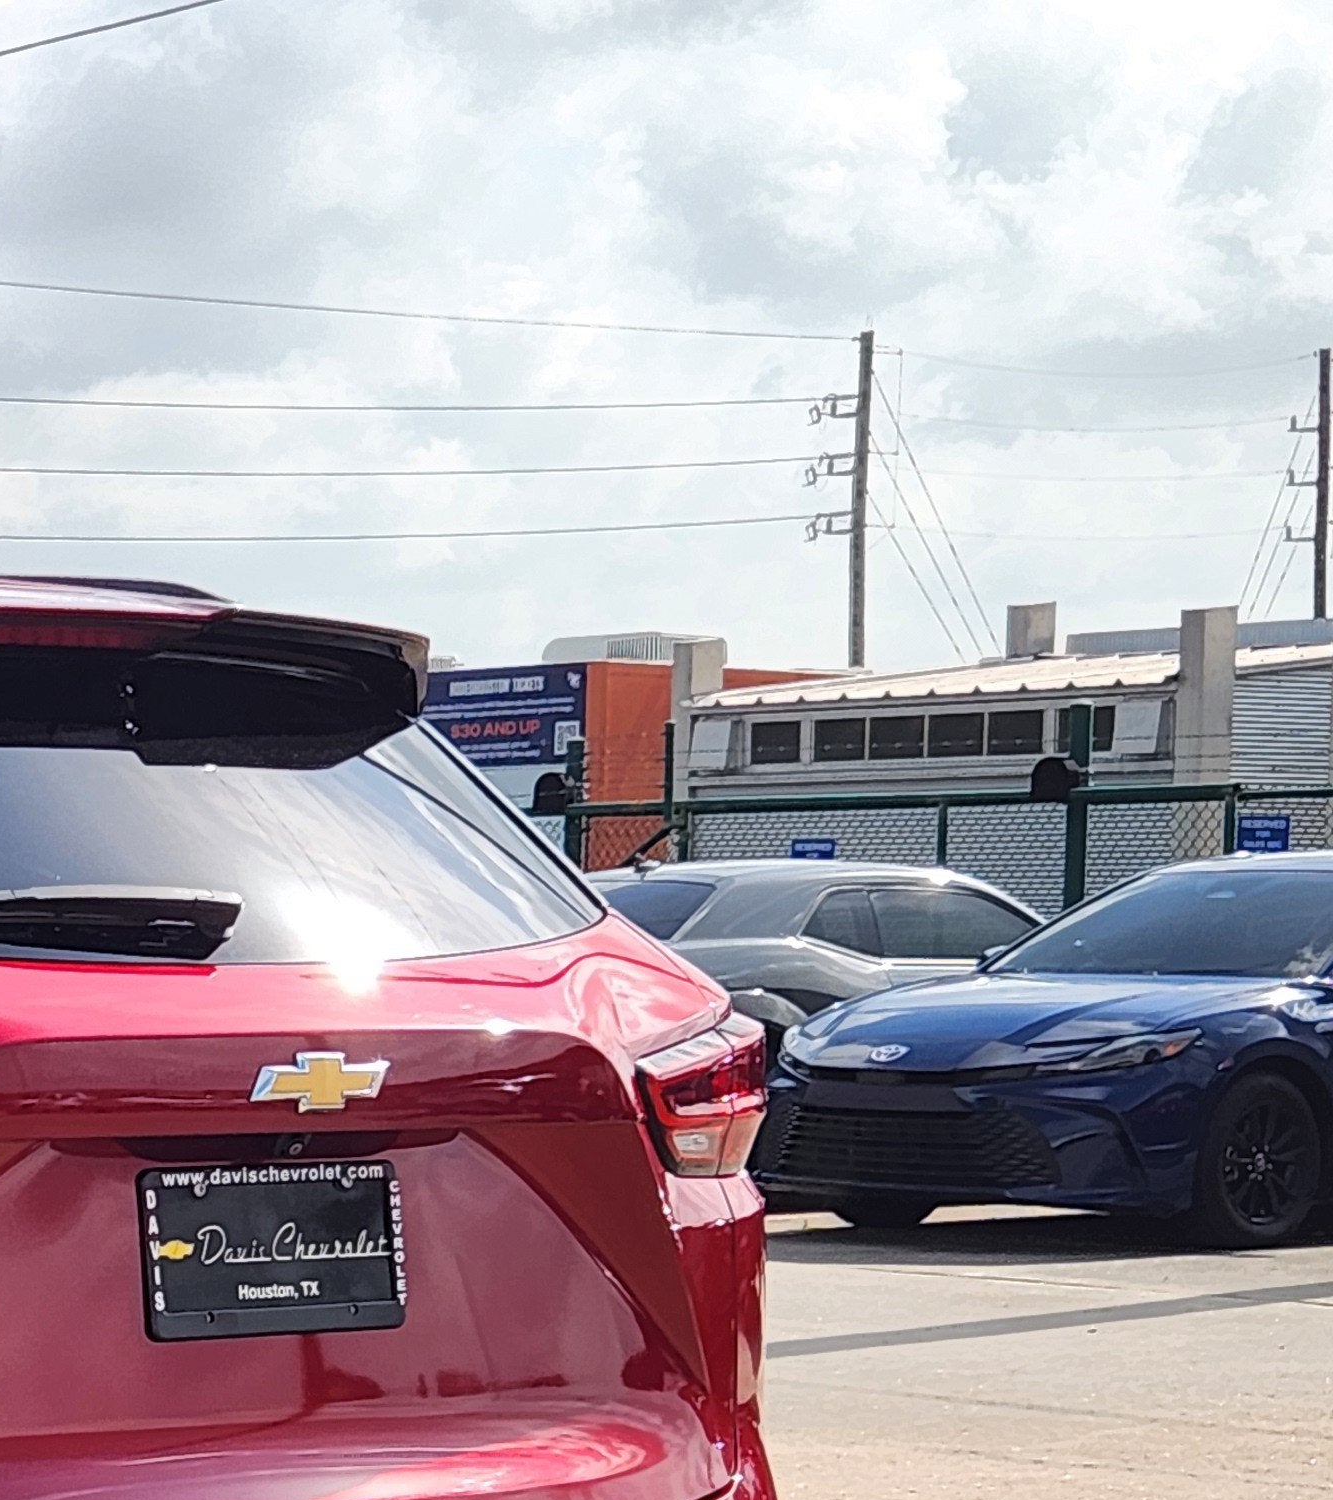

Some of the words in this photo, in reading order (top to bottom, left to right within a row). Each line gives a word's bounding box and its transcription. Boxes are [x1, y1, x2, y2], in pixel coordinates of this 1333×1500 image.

[483, 721, 517, 737] AND
[518, 719, 541, 734] UP
[161, 1164, 384, 1187] www.davischevrolet.com
[145, 1189, 166, 1312] DAVIS
[196, 1224, 271, 1265] Davis
[271, 1222, 392, 1262] Chevrolet
[388, 1180, 408, 1306] CHEVROLET
[238, 1284, 299, 1300] Houston,
[299, 1281, 321, 1297] TX
